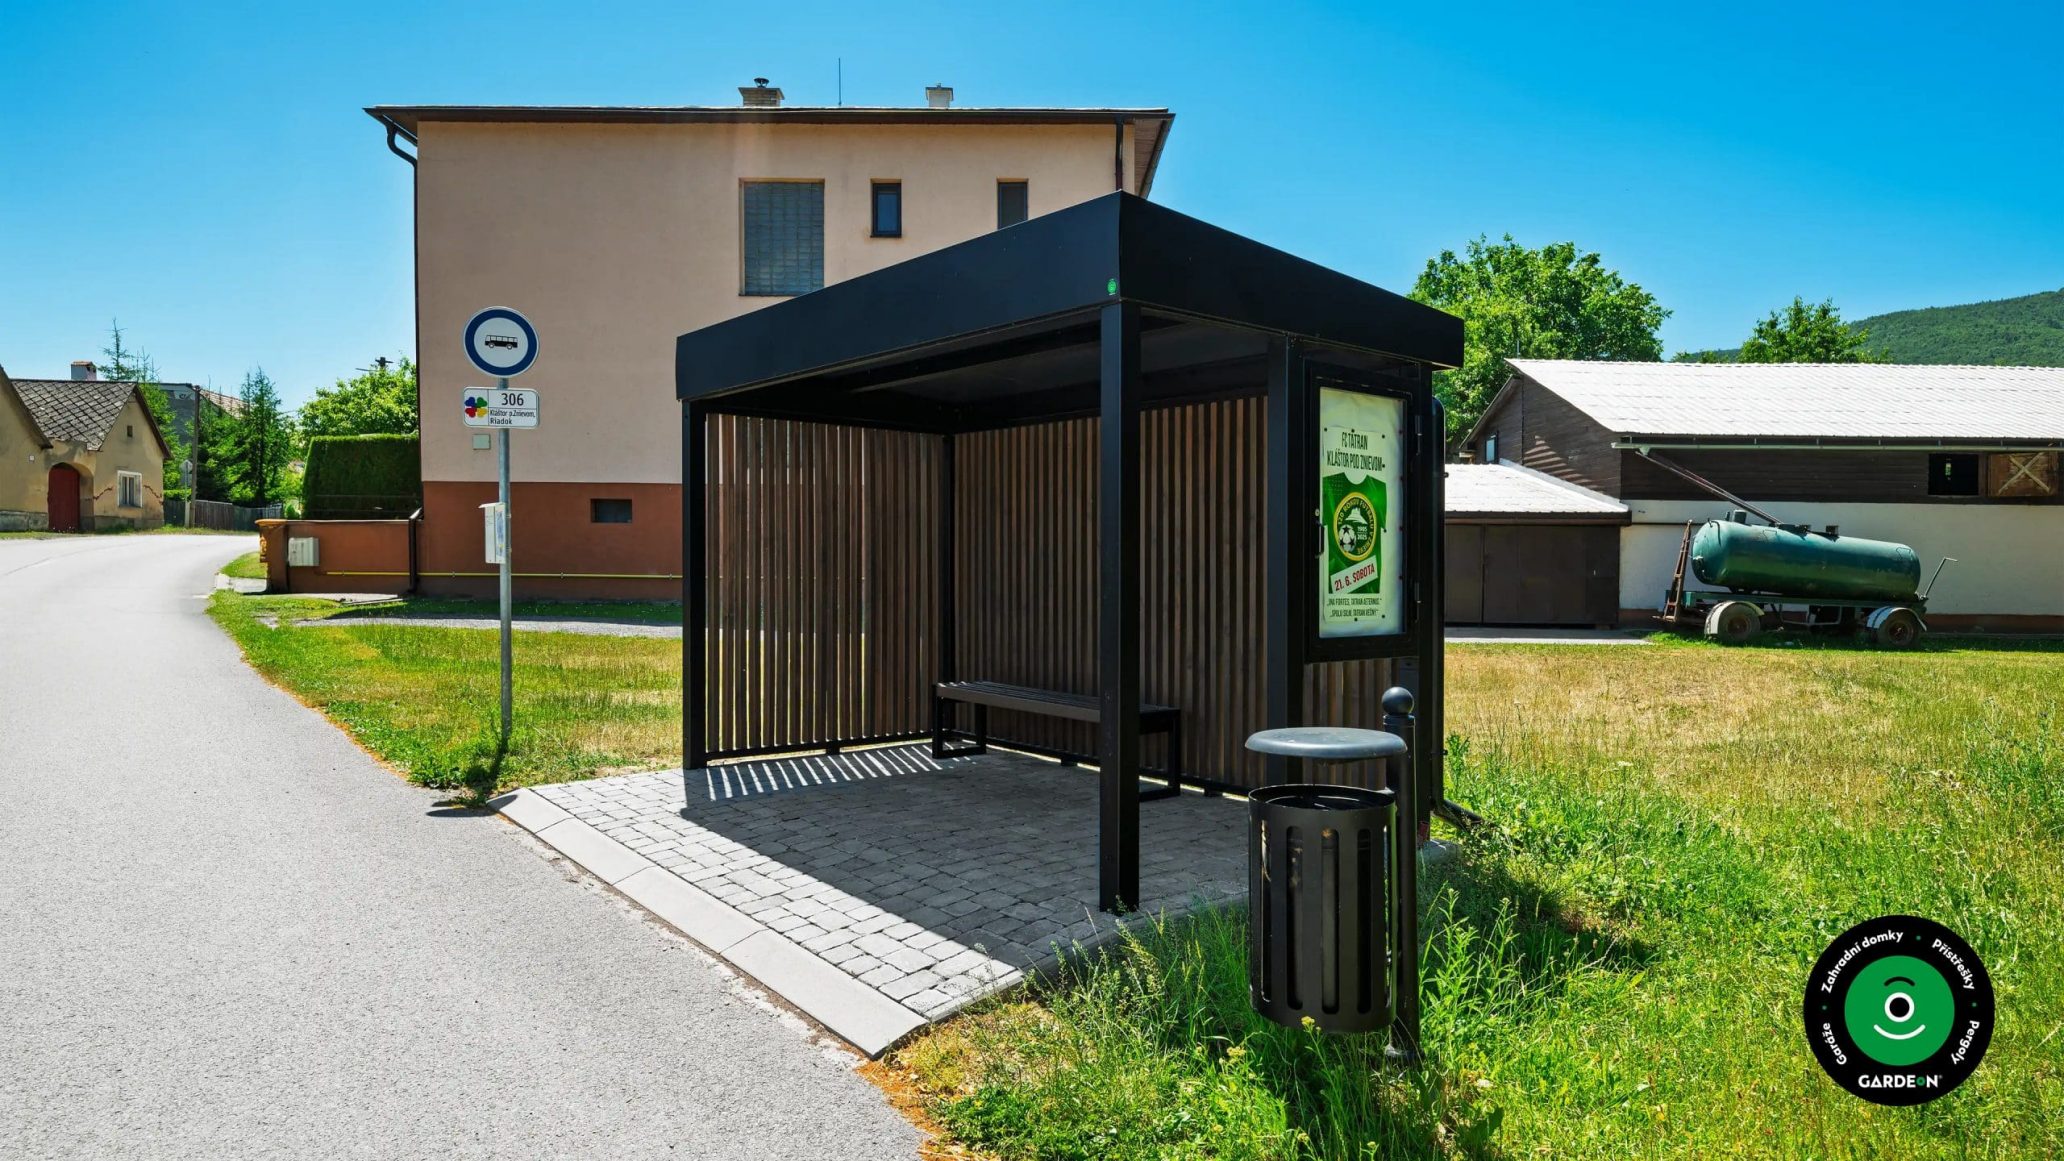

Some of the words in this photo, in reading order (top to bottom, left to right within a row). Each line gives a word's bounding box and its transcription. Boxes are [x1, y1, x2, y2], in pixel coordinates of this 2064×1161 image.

[501, 393, 524, 406] 306
[490, 417, 513, 425] Riadok
[1348, 433, 1368, 450] TATRAN
[1327, 448, 1350, 468] KLÁŠTOR
[1350, 453, 1360, 469] POD
[1334, 579, 1344, 591] 21.
[1345, 576, 1352, 586] 6.
[1352, 563, 1375, 583] SOBOTA
